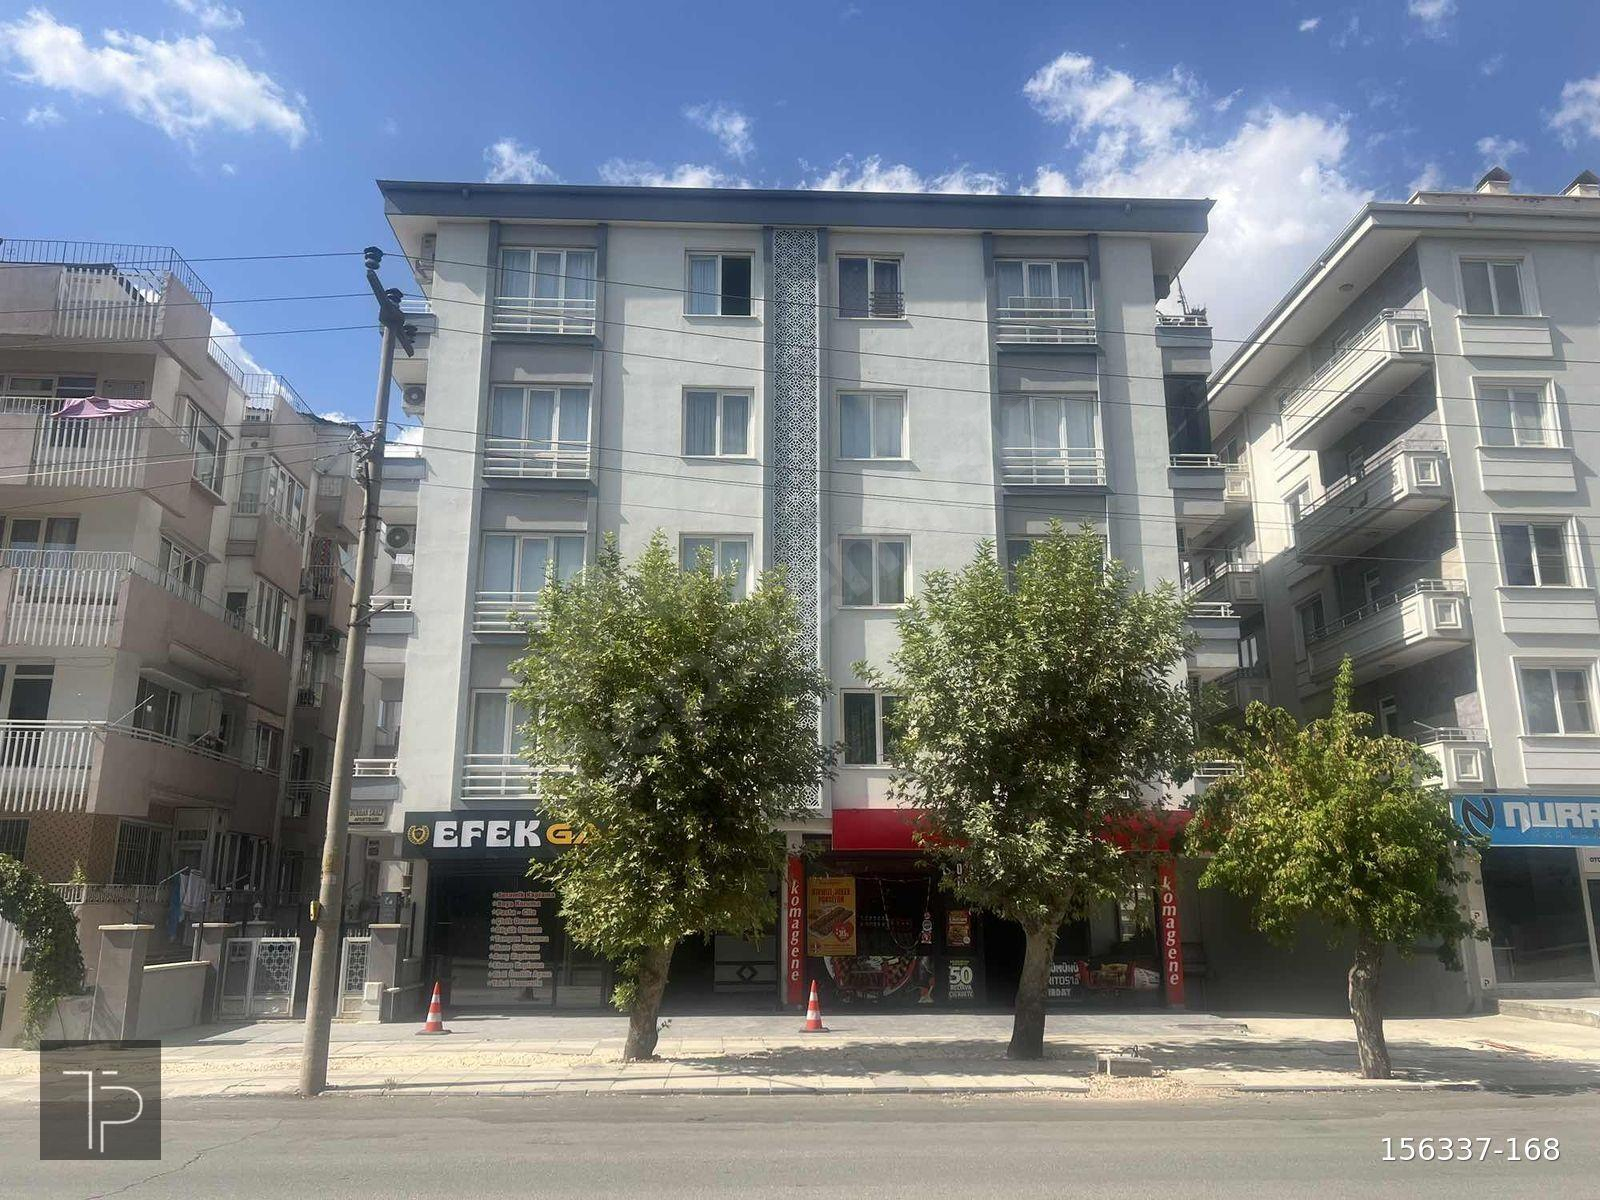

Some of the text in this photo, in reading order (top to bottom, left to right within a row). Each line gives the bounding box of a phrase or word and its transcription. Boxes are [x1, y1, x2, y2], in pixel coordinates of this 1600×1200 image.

[432, 820, 542, 848] EFEK
[789, 881, 801, 981] komagene
[1161, 876, 1180, 985] komagene
[949, 966, 973, 985] 50
